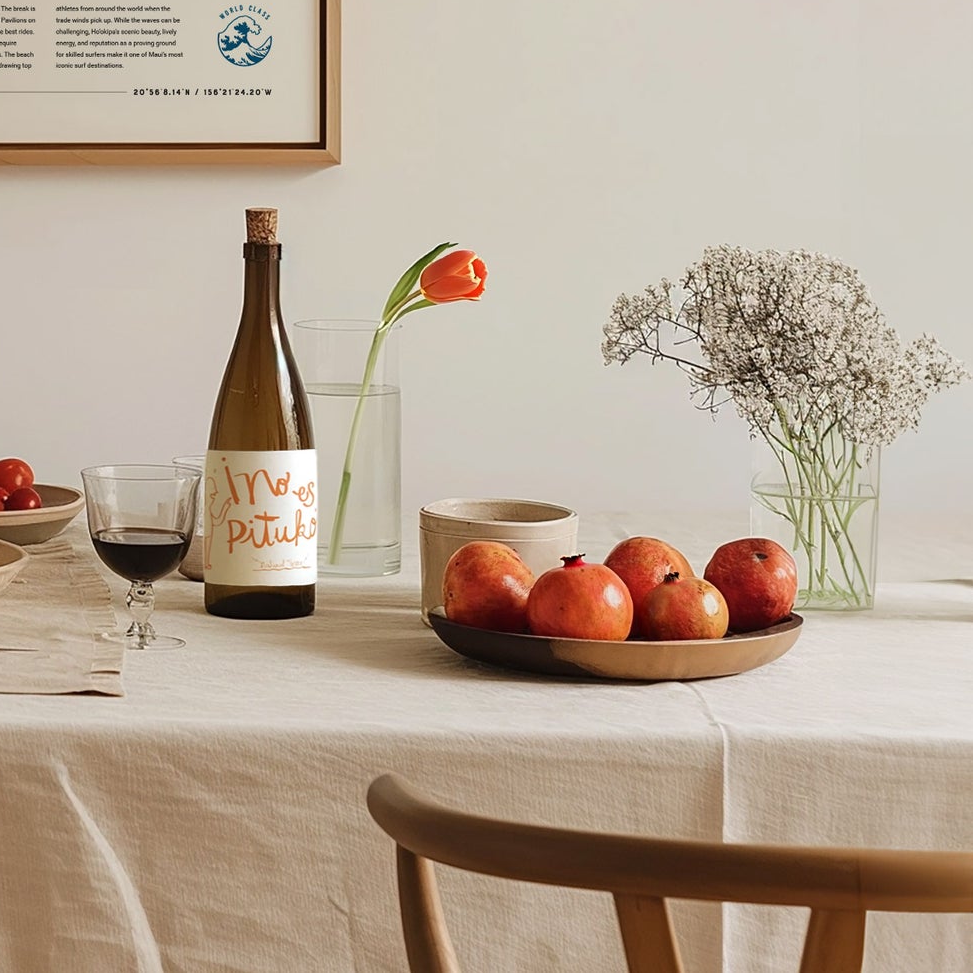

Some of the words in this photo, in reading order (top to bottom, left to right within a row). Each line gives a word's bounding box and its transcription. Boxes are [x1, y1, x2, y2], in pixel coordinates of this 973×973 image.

[219, 4, 244, 20] WORLD
[248, 5, 271, 21] CLASS
[56, 28, 91, 36] challenging,
[141, 28, 161, 36] beauty,
[162, 28, 177, 36] lively
[292, 481, 314, 507] es
